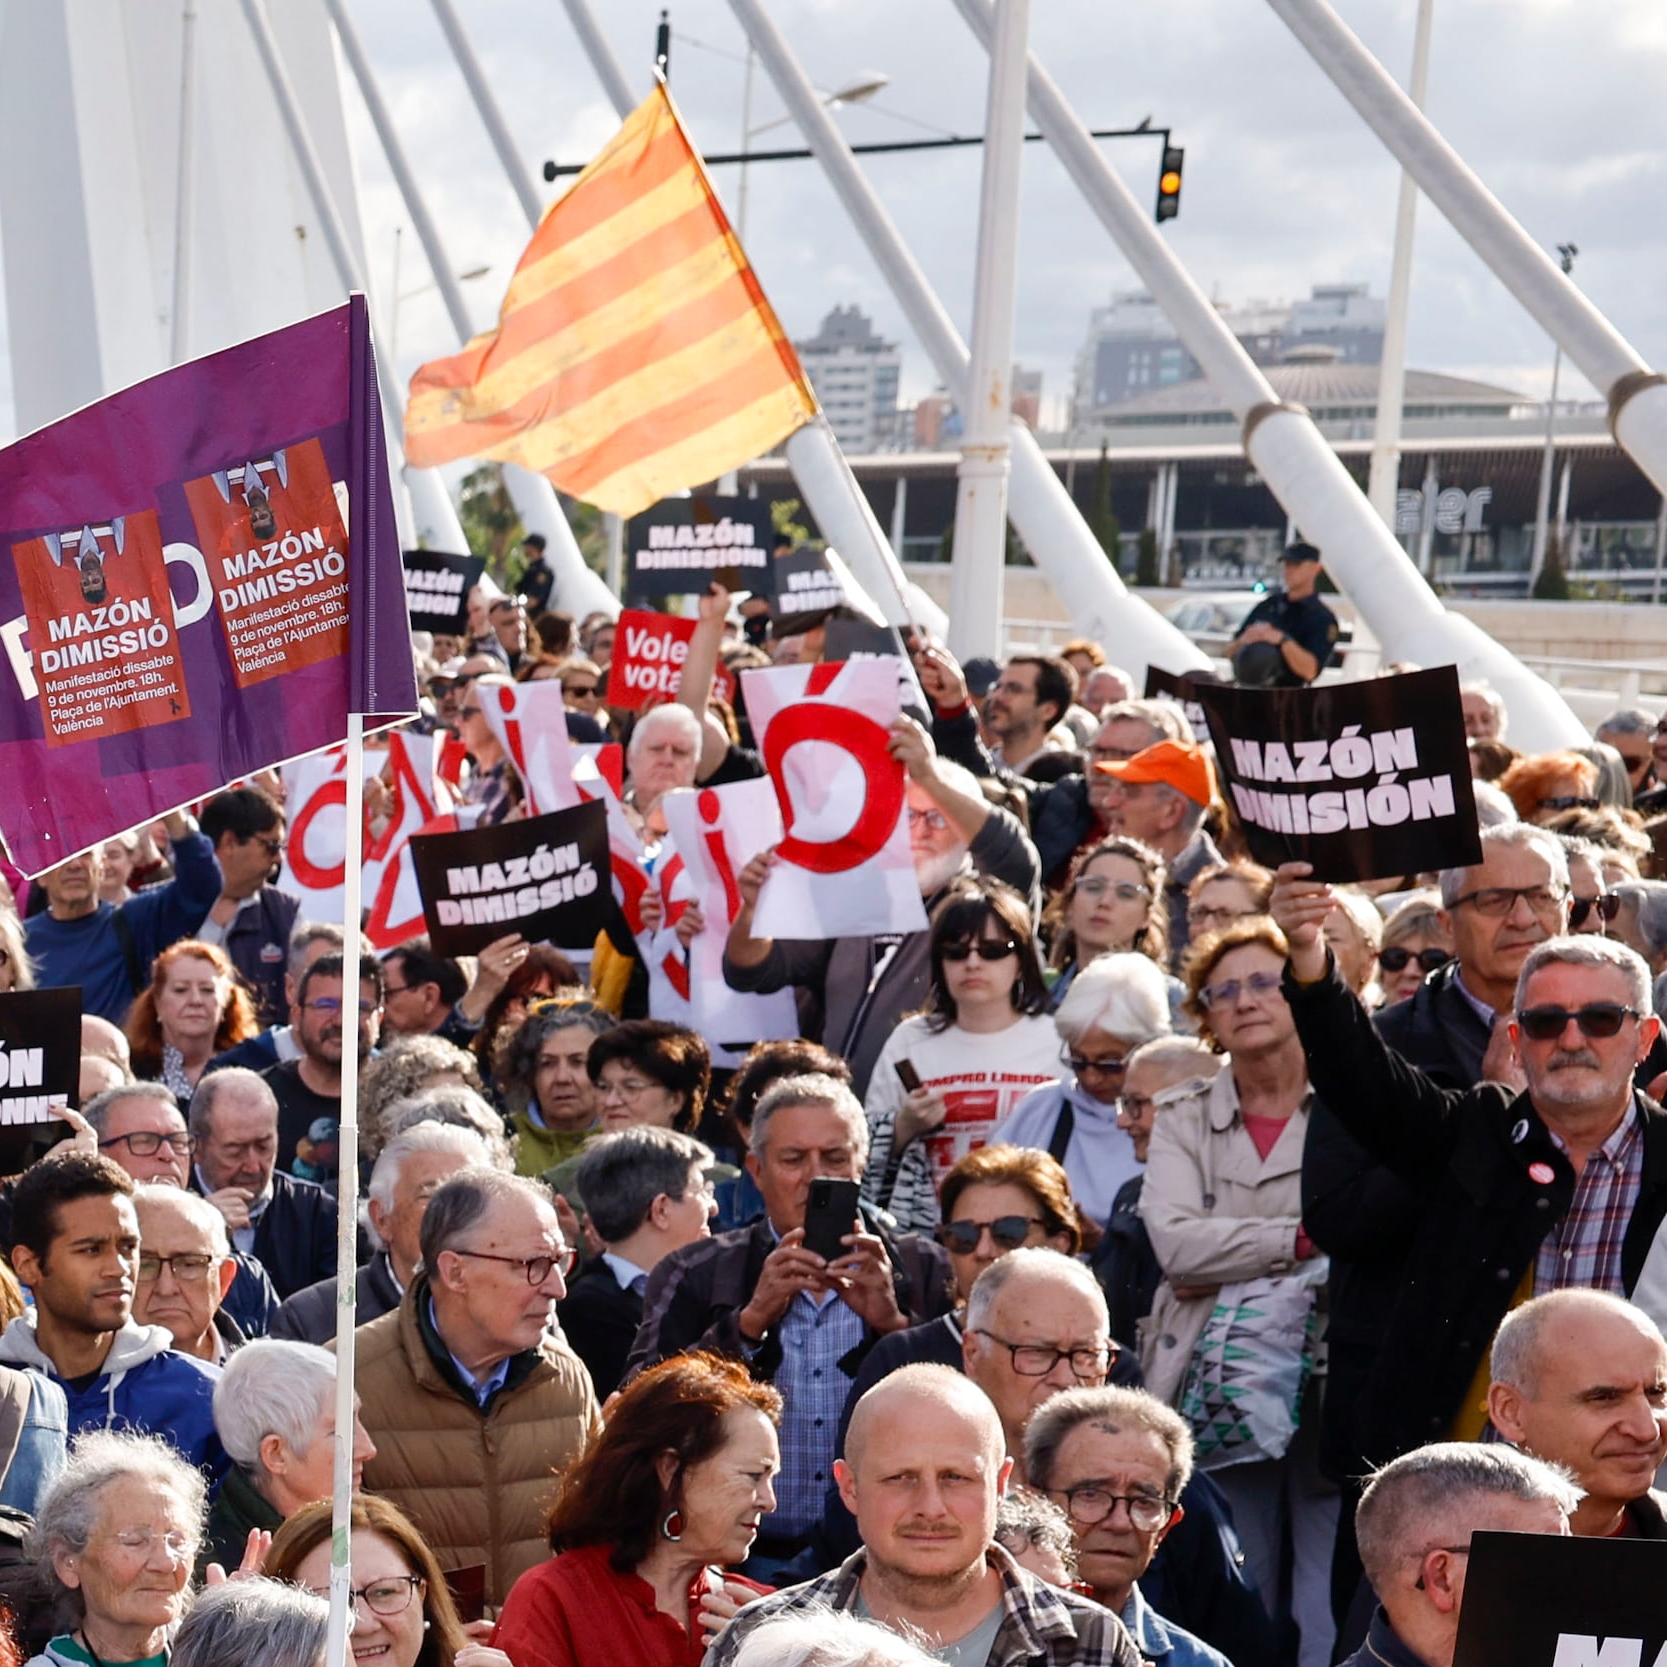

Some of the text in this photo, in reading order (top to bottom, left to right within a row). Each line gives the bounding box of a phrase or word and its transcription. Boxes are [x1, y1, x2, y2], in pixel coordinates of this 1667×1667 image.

[648, 516, 755, 549] MAZÓN
[221, 527, 325, 581] MAZÓN
[635, 547, 766, 571] DIMISSIONI
[219, 546, 346, 613] DIMISSIÓ
[48, 597, 152, 642] MAZÓN
[226, 598, 301, 633] Manifestació
[229, 601, 346, 647] 9 de novembre. 18h.
[40, 618, 169, 674] DIMISSIÓ
[234, 643, 266, 662] Plaça
[266, 636, 283, 650] de
[237, 649, 287, 675] València
[624, 626, 689, 665] Vole
[45, 653, 174, 694] Manifestació dissabte
[48, 672, 165, 708] 9 de novembre. 18h.
[50, 682, 179, 722] Plaça de l'Ajuntament.
[52, 715, 105, 736] València
[1230, 724, 1418, 783] MAZÓN
[1231, 771, 1456, 835] DIMISIÓN
[447, 844, 581, 895] MAZÓN
[436, 862, 598, 927] DIMISSIÓ
